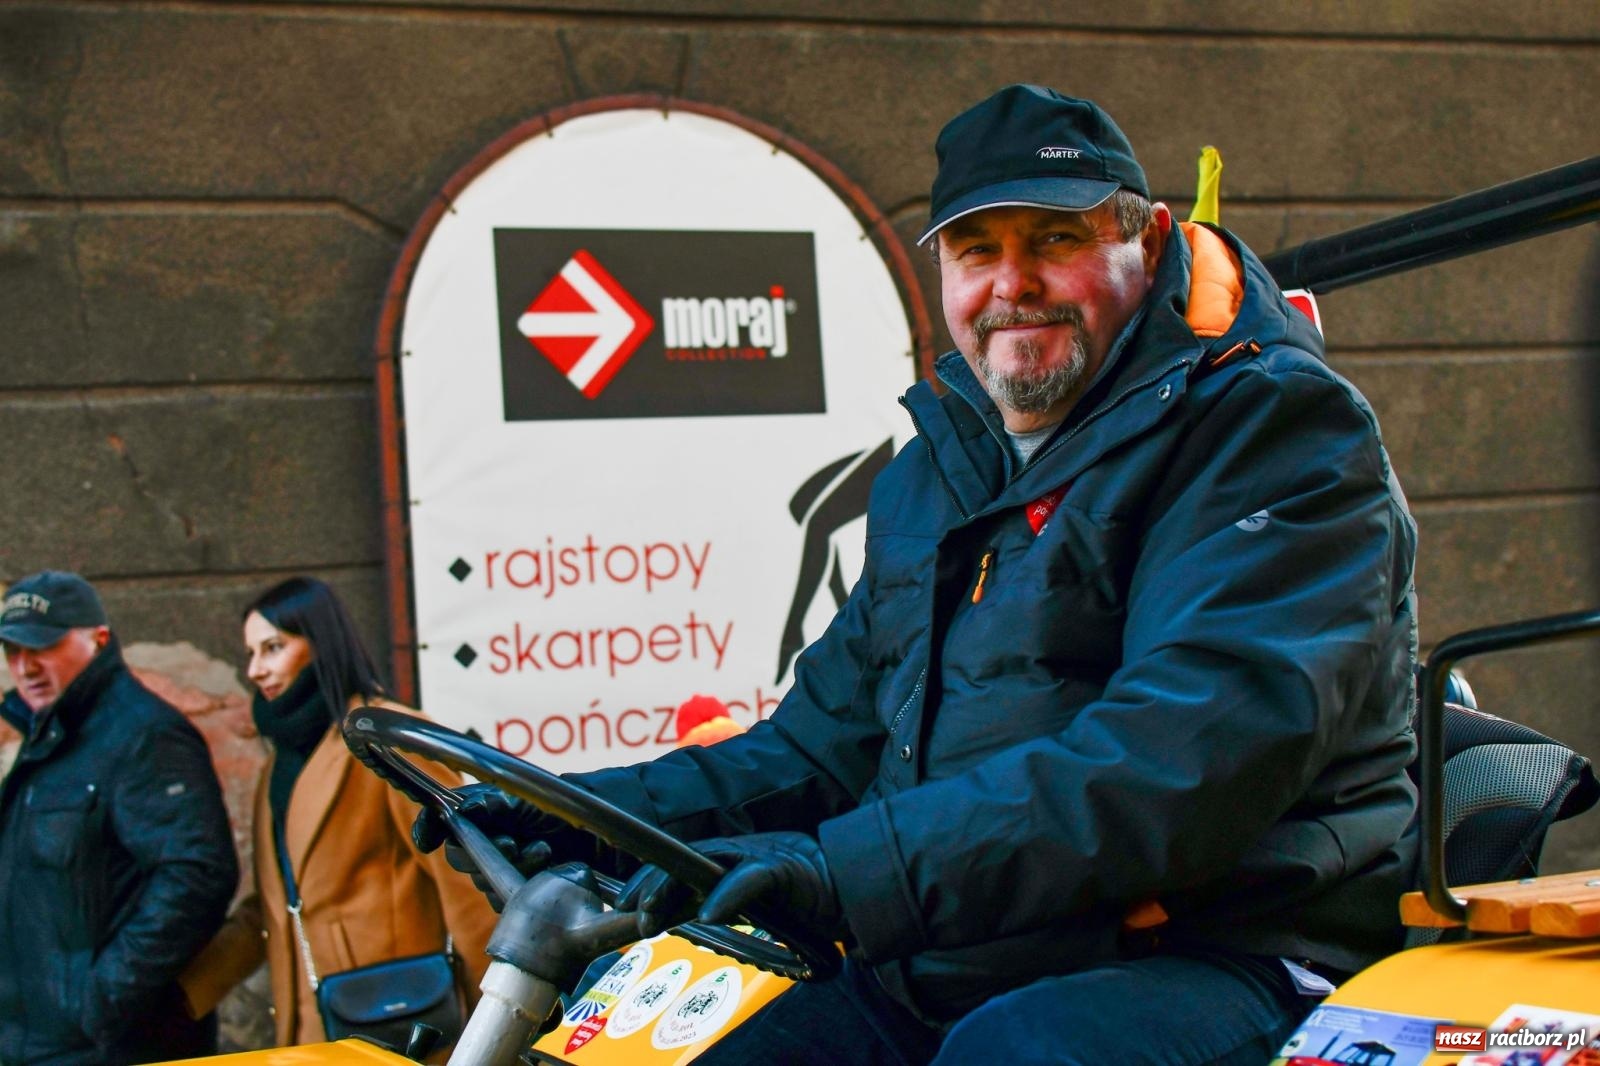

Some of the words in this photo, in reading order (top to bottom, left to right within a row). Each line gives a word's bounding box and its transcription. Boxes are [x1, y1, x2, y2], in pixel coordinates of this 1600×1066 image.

[1041, 151, 1079, 159] MARTEX
[661, 284, 788, 358] moraj
[663, 347, 768, 361] COLLECTION
[484, 534, 712, 599] rajstopy
[488, 611, 734, 677] skarpety
